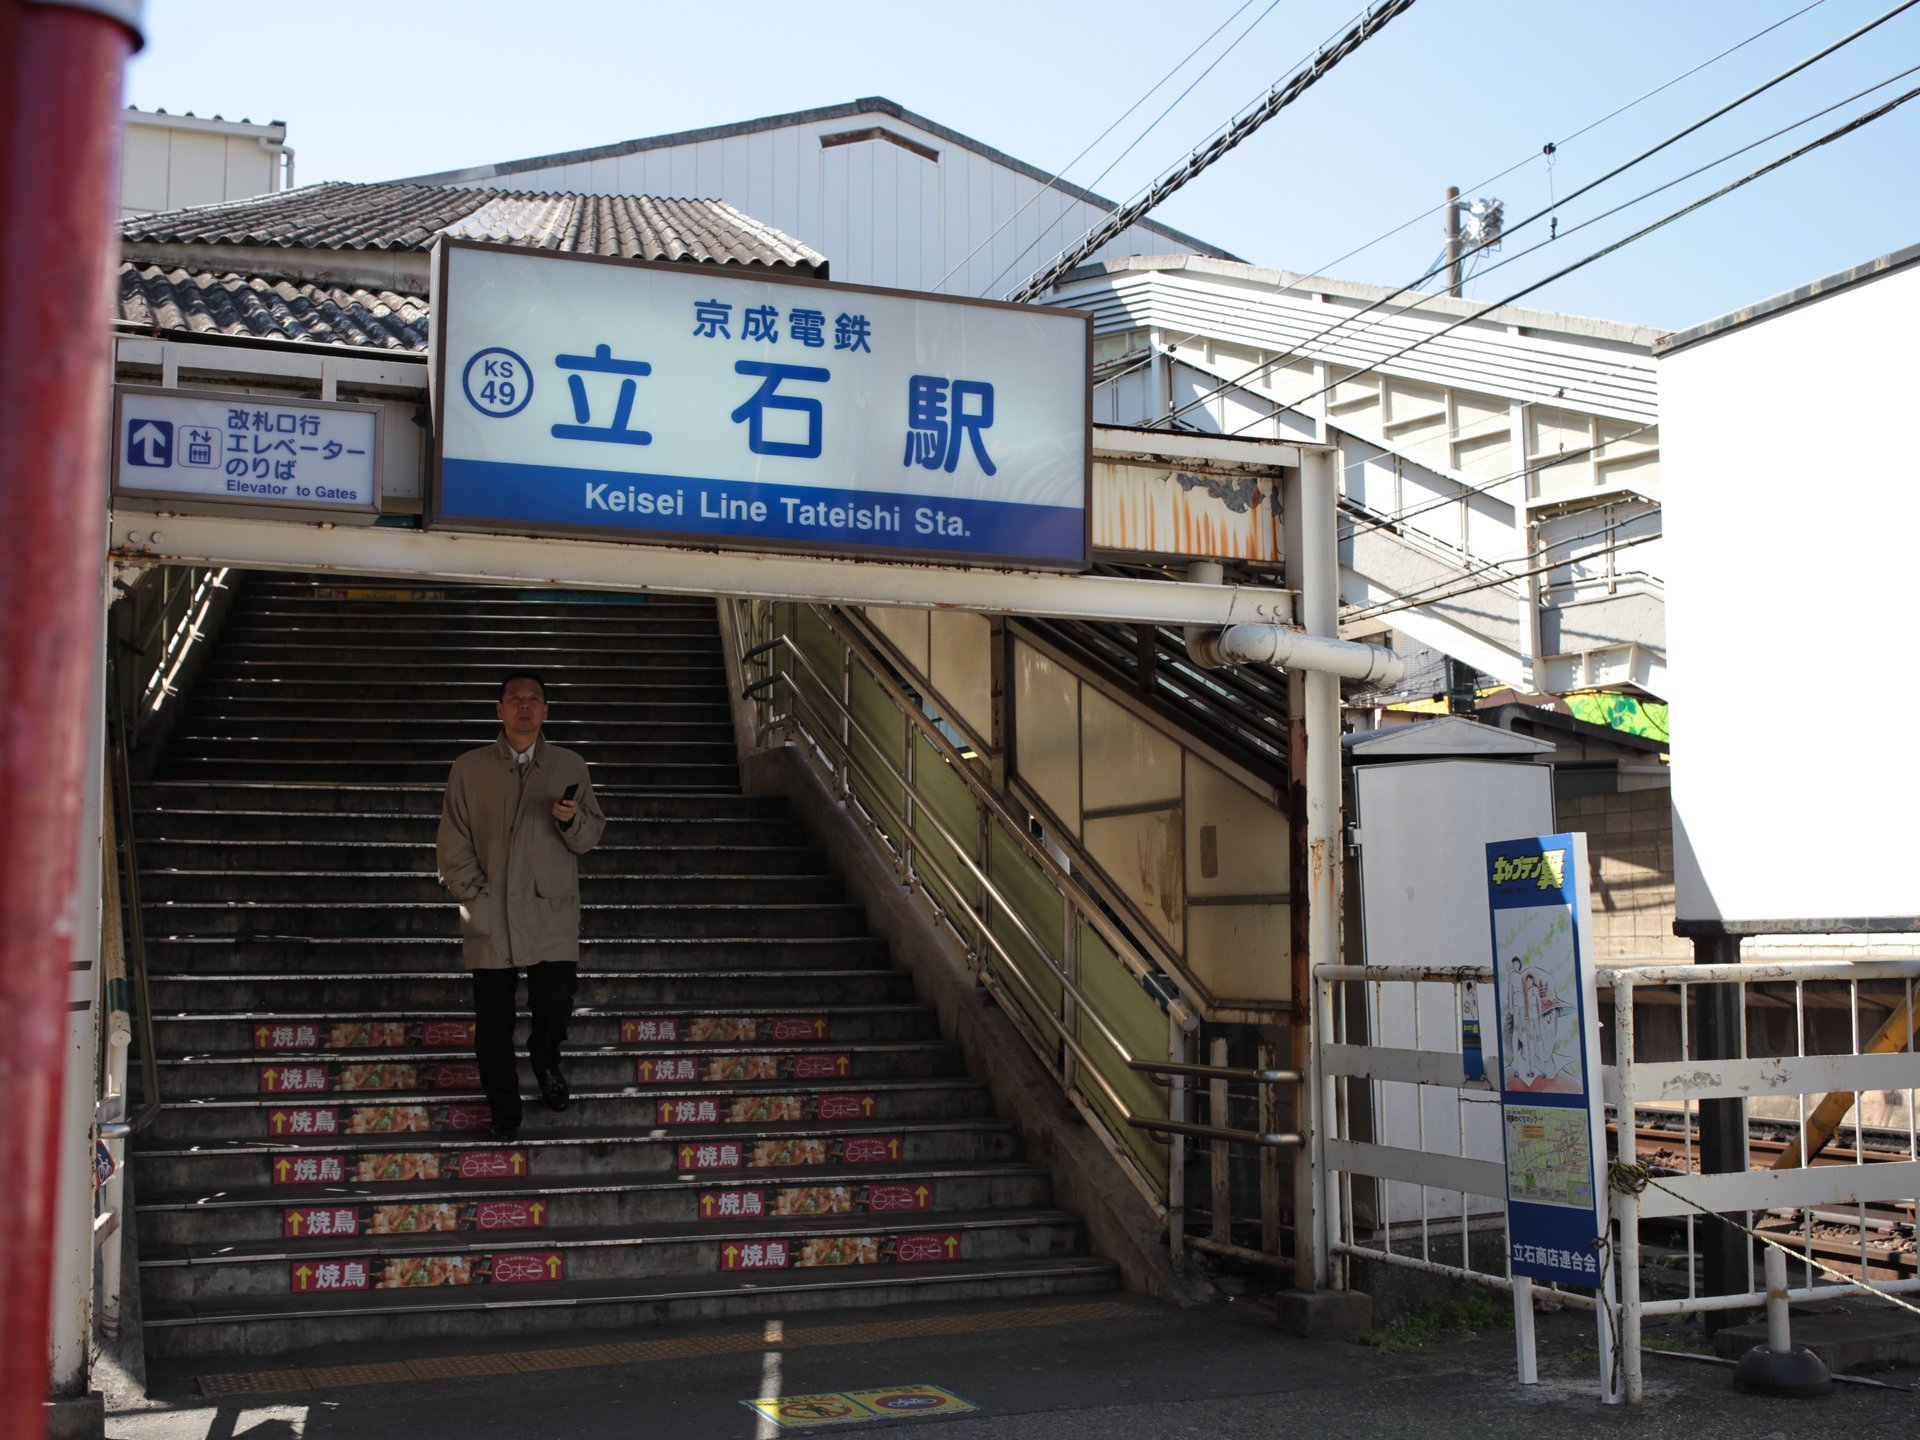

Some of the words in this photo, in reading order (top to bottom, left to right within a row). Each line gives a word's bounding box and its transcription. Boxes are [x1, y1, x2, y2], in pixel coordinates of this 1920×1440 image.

[693, 298, 872, 354] 京成電鉄
[484, 359, 514, 379] KS
[480, 380, 516, 406] 49
[227, 408, 322, 437] 改札口行
[550, 343, 997, 477] 立石駅
[226, 433, 366, 461] エレベーター
[225, 457, 297, 481] のりば
[226, 480, 288, 497] Elevator
[296, 484, 311, 498] to
[315, 485, 358, 501] Gates
[585, 482, 684, 516] Keisei
[700, 491, 768, 523] Line
[780, 497, 900, 532] Tateishi
[914, 507, 972, 538] Sta.
[1492, 848, 1566, 891] キャプテン翼
[272, 1025, 316, 1047] 焼鳥
[637, 1021, 677, 1042] 焼鳥
[281, 1067, 325, 1090] 焼鳥
[655, 1058, 695, 1081] 焼鳥
[289, 1110, 336, 1134] 焼鳥
[675, 1100, 717, 1123] 焼鳥
[697, 1144, 739, 1168] 焼鳥
[293, 1157, 341, 1182] 焼鳥
[718, 1192, 762, 1216] 焼鳥
[306, 1208, 357, 1235] 焼鳥
[740, 1242, 786, 1268] 焼鳥
[1512, 1242, 1597, 1273] 立石商店連合会
[314, 1261, 367, 1289] 焼鳥
